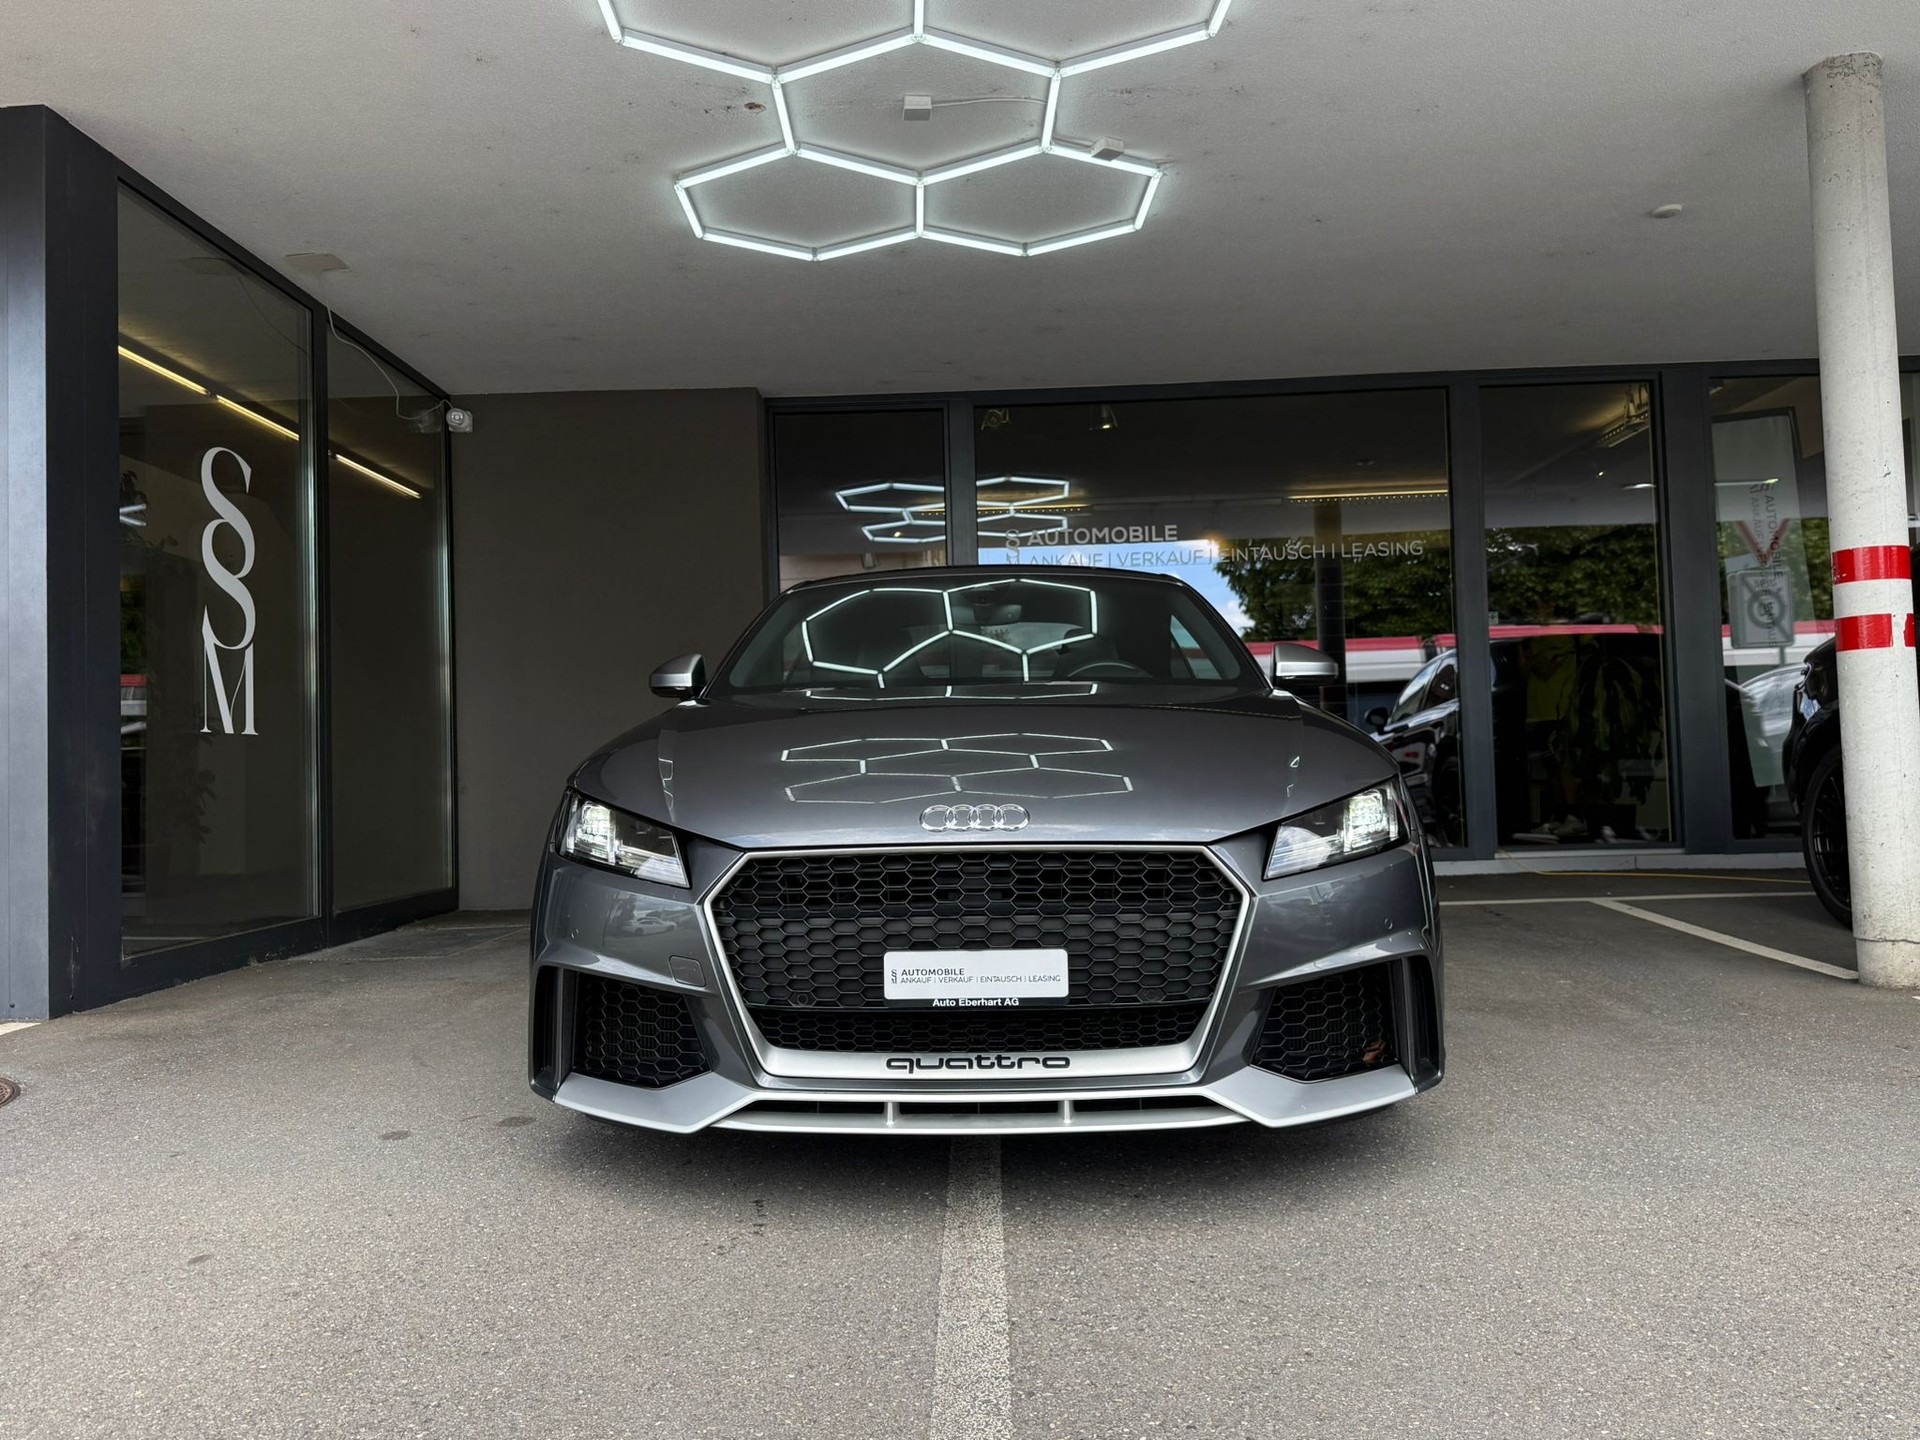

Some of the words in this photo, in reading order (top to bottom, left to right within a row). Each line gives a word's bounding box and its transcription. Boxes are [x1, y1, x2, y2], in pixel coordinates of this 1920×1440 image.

[1026, 524, 1178, 546] AUTOMOBILE
[1030, 551, 1104, 568] ANKAUF
[1115, 548, 1204, 568] VERKAUF
[1219, 542, 1326, 563] EINTAUSCH
[1340, 539, 1425, 559] LEASING
[900, 976, 932, 984] ANKAUF
[938, 975, 974, 984] VERKAUF
[980, 975, 1022, 983] EINTAUSCH
[1028, 974, 1061, 982] LEASING
[901, 968, 965, 977] AUTOMOBILE
[932, 998, 956, 1007] Auto
[958, 998, 1002, 1007] Eberhart
[1004, 997, 1020, 1006] AG
[886, 1054, 1071, 1075] quattro
